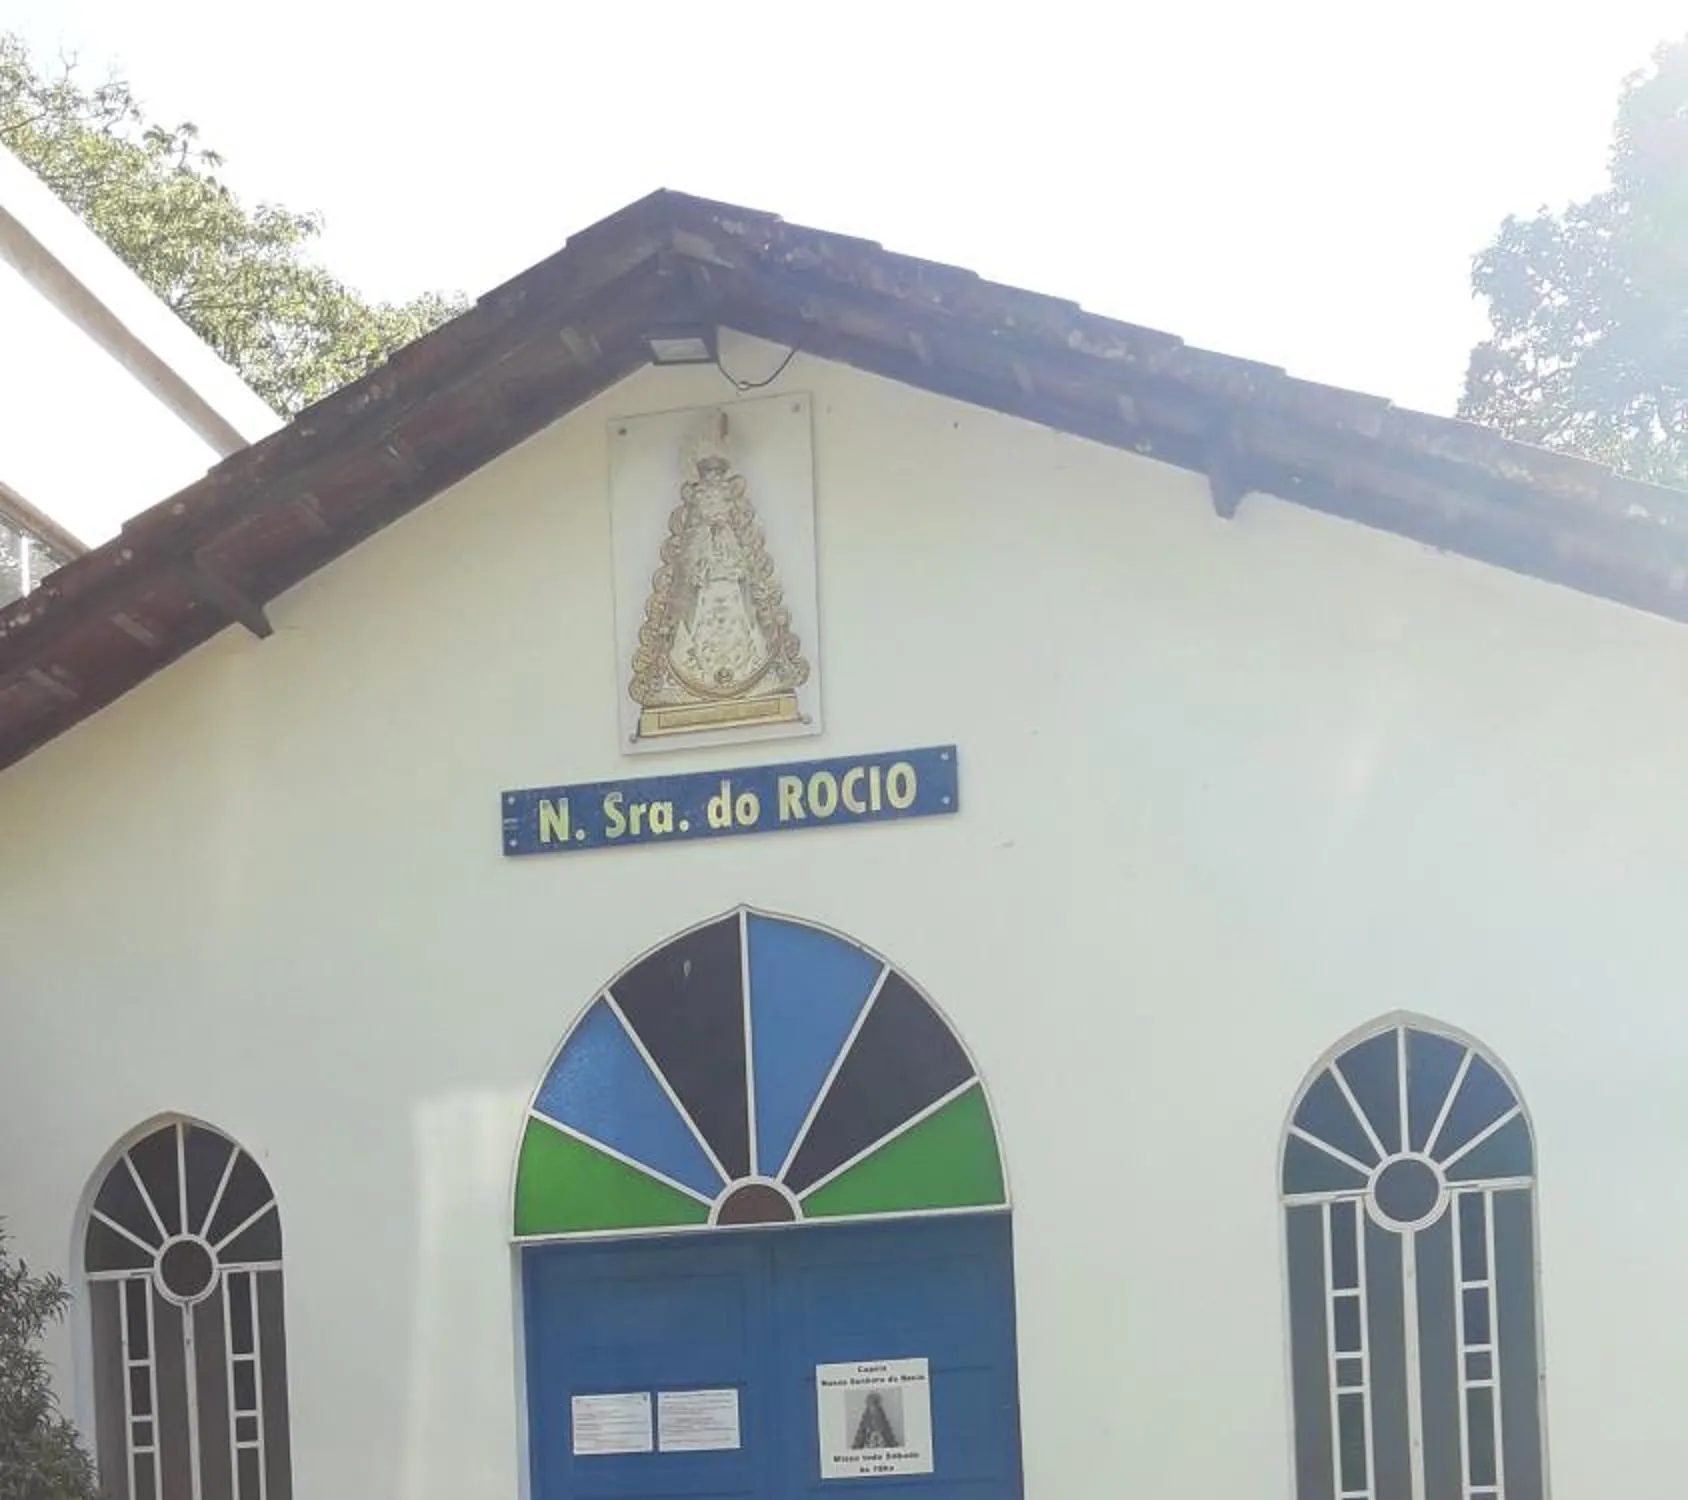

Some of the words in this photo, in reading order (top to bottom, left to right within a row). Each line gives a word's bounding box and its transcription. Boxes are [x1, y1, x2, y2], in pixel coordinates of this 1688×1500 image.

[538, 797, 587, 844] N.
[603, 791, 691, 840] Sra.
[706, 780, 761, 830] do
[777, 761, 918, 822] ROCIO
